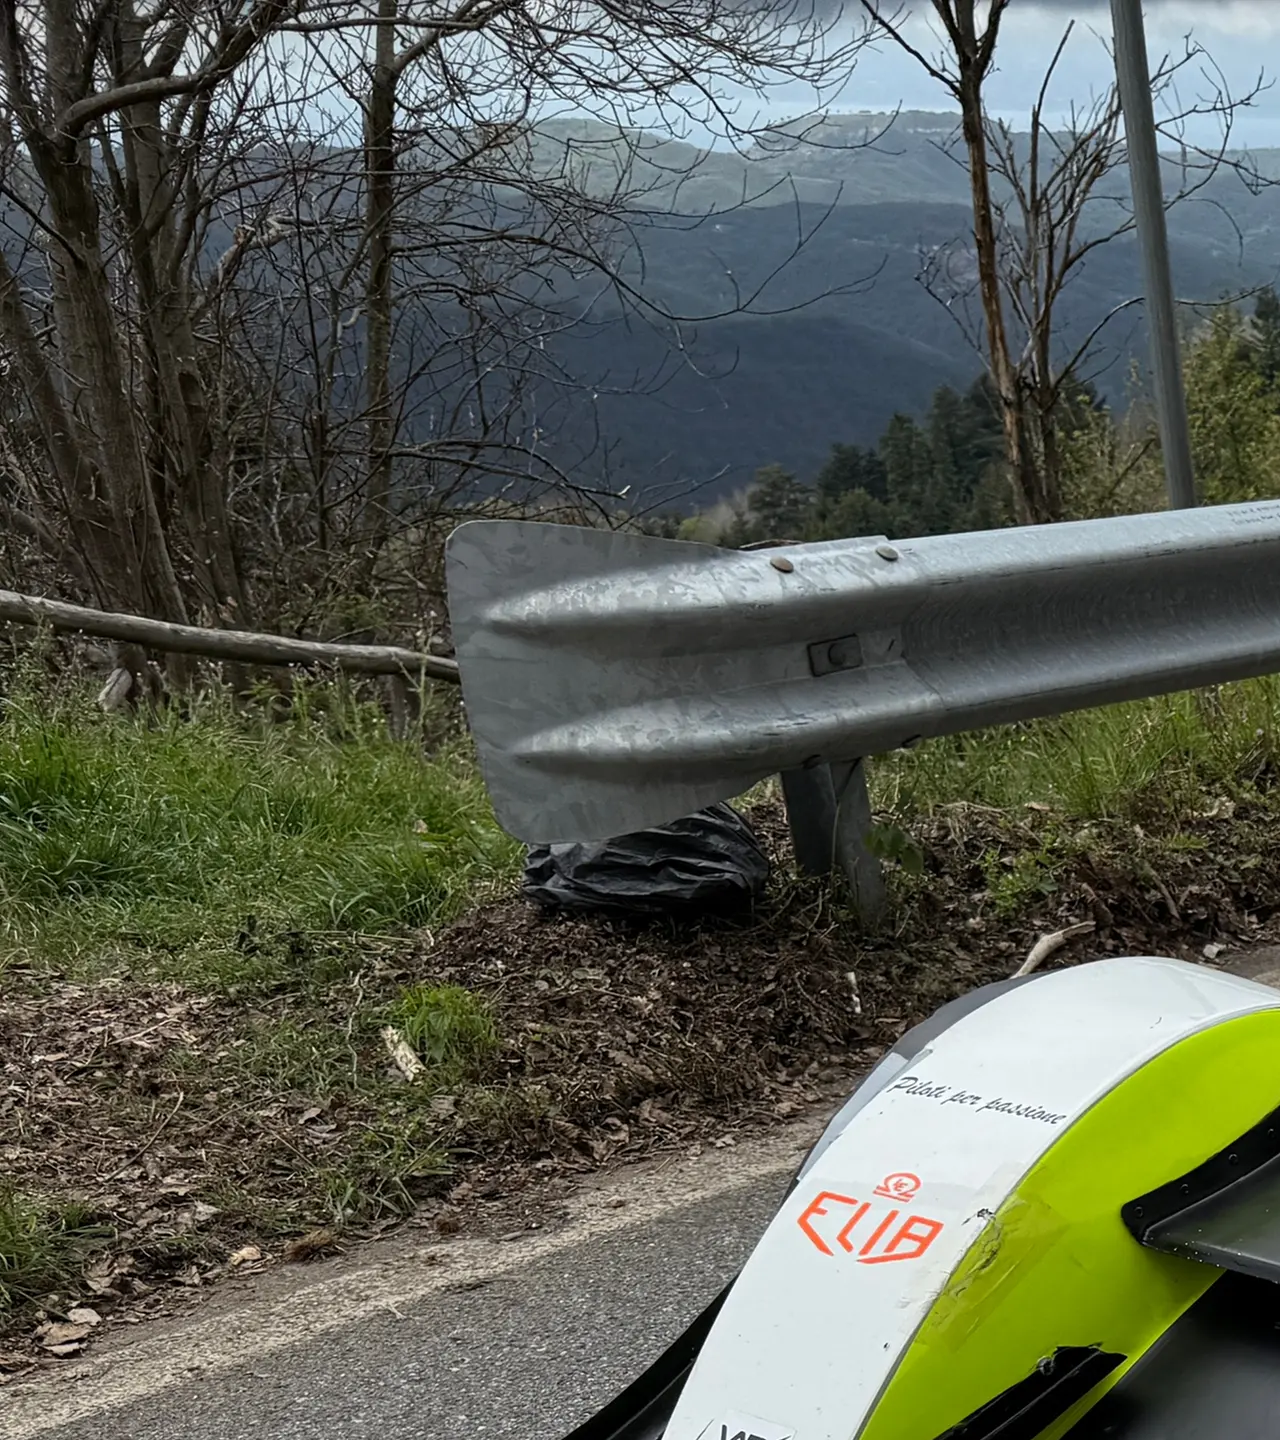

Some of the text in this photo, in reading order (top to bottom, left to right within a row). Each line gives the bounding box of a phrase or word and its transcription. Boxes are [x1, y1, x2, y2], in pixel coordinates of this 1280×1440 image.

[888, 1076, 1068, 1125] Piloti per passione
[796, 1190, 945, 1265] ELIA
